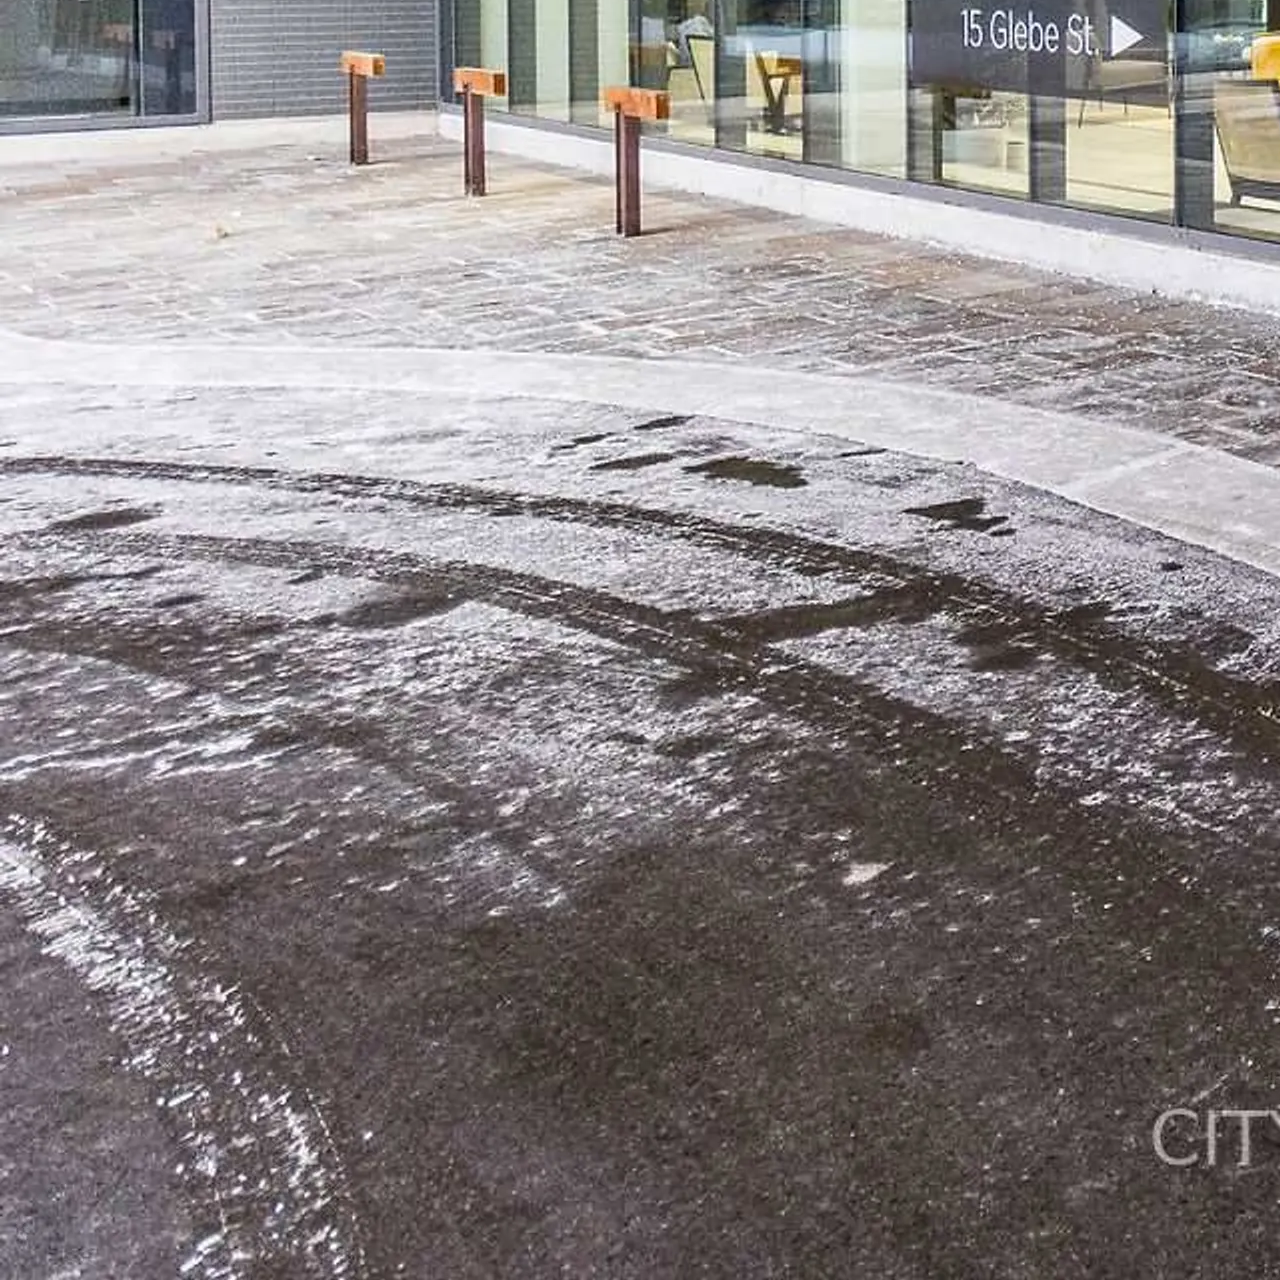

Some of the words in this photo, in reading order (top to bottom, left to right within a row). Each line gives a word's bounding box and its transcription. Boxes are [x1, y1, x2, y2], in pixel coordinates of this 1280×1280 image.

[960, 8, 984, 48] 15
[990, 9, 1060, 52] Glebe
[1066, 13, 1101, 56] St.
